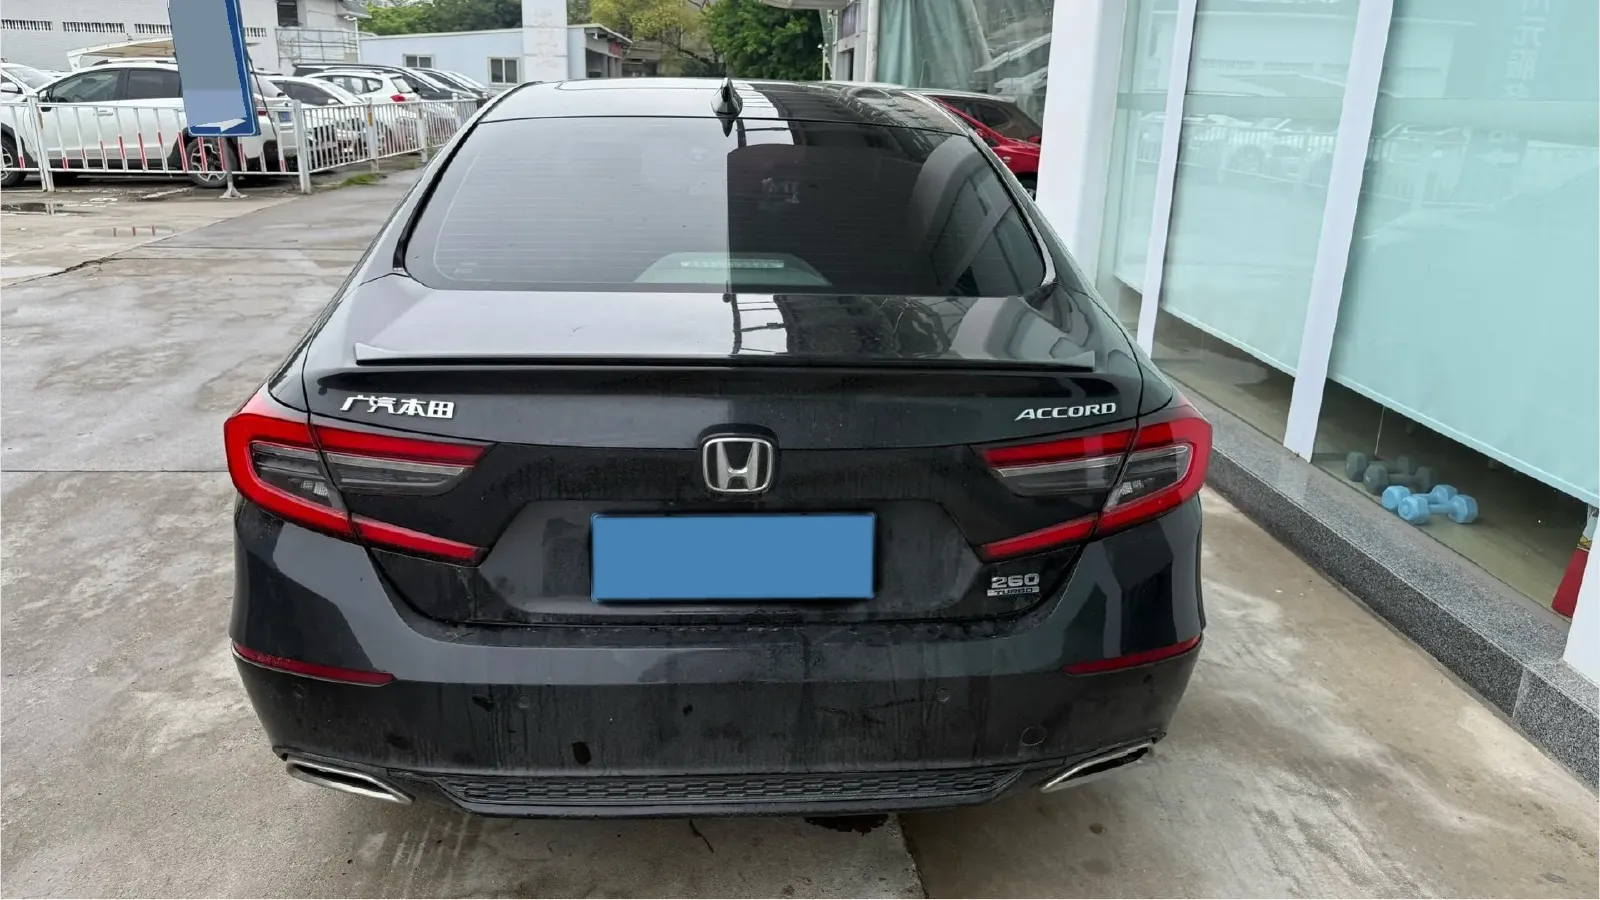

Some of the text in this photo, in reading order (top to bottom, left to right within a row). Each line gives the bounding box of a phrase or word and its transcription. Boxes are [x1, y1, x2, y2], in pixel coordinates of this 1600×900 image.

[340, 395, 454, 418] 广汽本田
[1014, 402, 1117, 421] ACCORD
[991, 573, 1040, 588] 260
